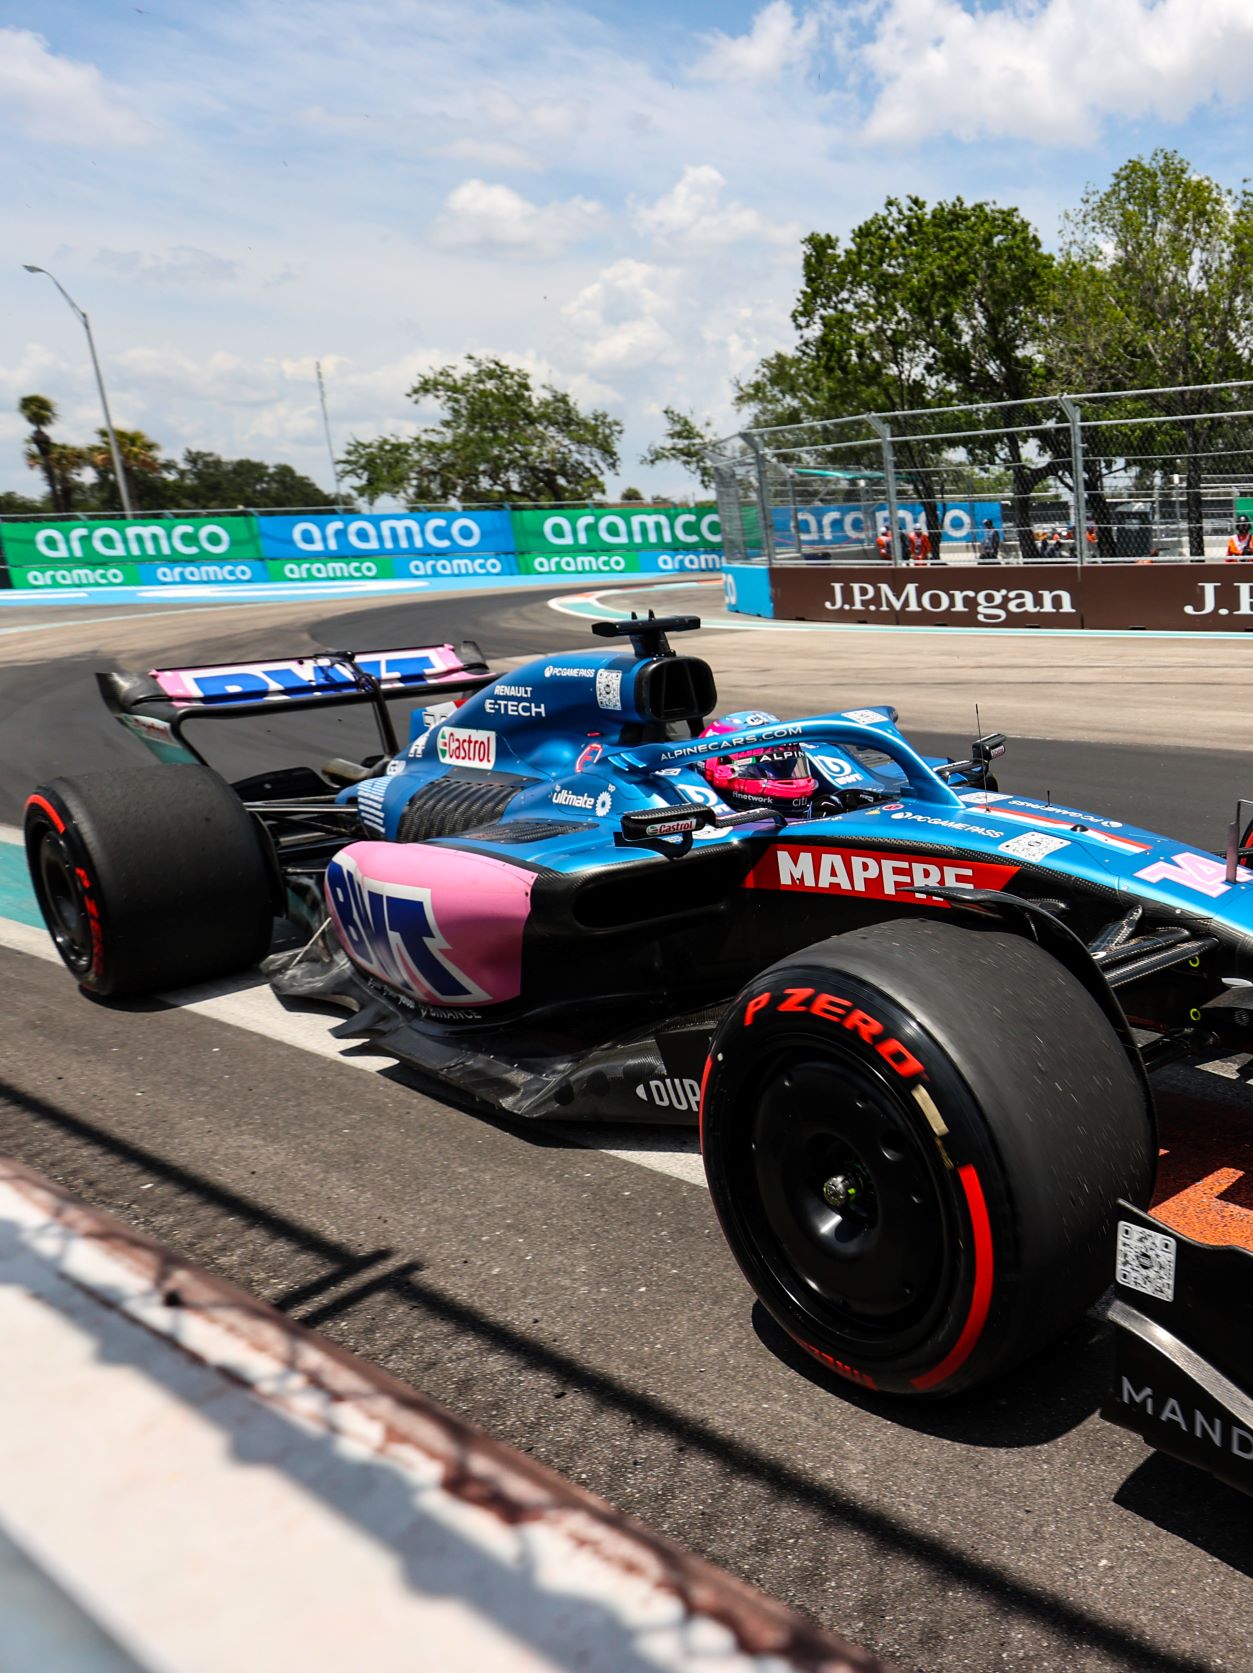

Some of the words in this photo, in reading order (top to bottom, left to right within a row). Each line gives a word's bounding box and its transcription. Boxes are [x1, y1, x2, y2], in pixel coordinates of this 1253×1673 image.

[292, 518, 481, 551] aramco
[543, 513, 722, 545] aramco
[35, 524, 230, 558] aramco
[156, 564, 252, 583] aramco
[284, 560, 378, 579] aramco
[408, 557, 501, 576] aramco
[533, 554, 626, 573] aramco
[27, 568, 124, 586] aramco
[824, 582, 1077, 623] J.P.Morgan
[494, 685, 532, 698] RENAULT
[484, 699, 546, 717] E-TECH
[448, 732, 491, 763] Castrol
[660, 726, 803, 762] ALPINECARS.COM
[552, 789, 595, 809] ultimate
[658, 821, 693, 834] Castrol
[910, 814, 928, 823] PC
[928, 818, 967, 832] GAME
[964, 825, 1004, 838] PASS
[776, 850, 975, 902] MAPFRE
[743, 991, 772, 1027] P
[776, 987, 929, 1081] ZERO
